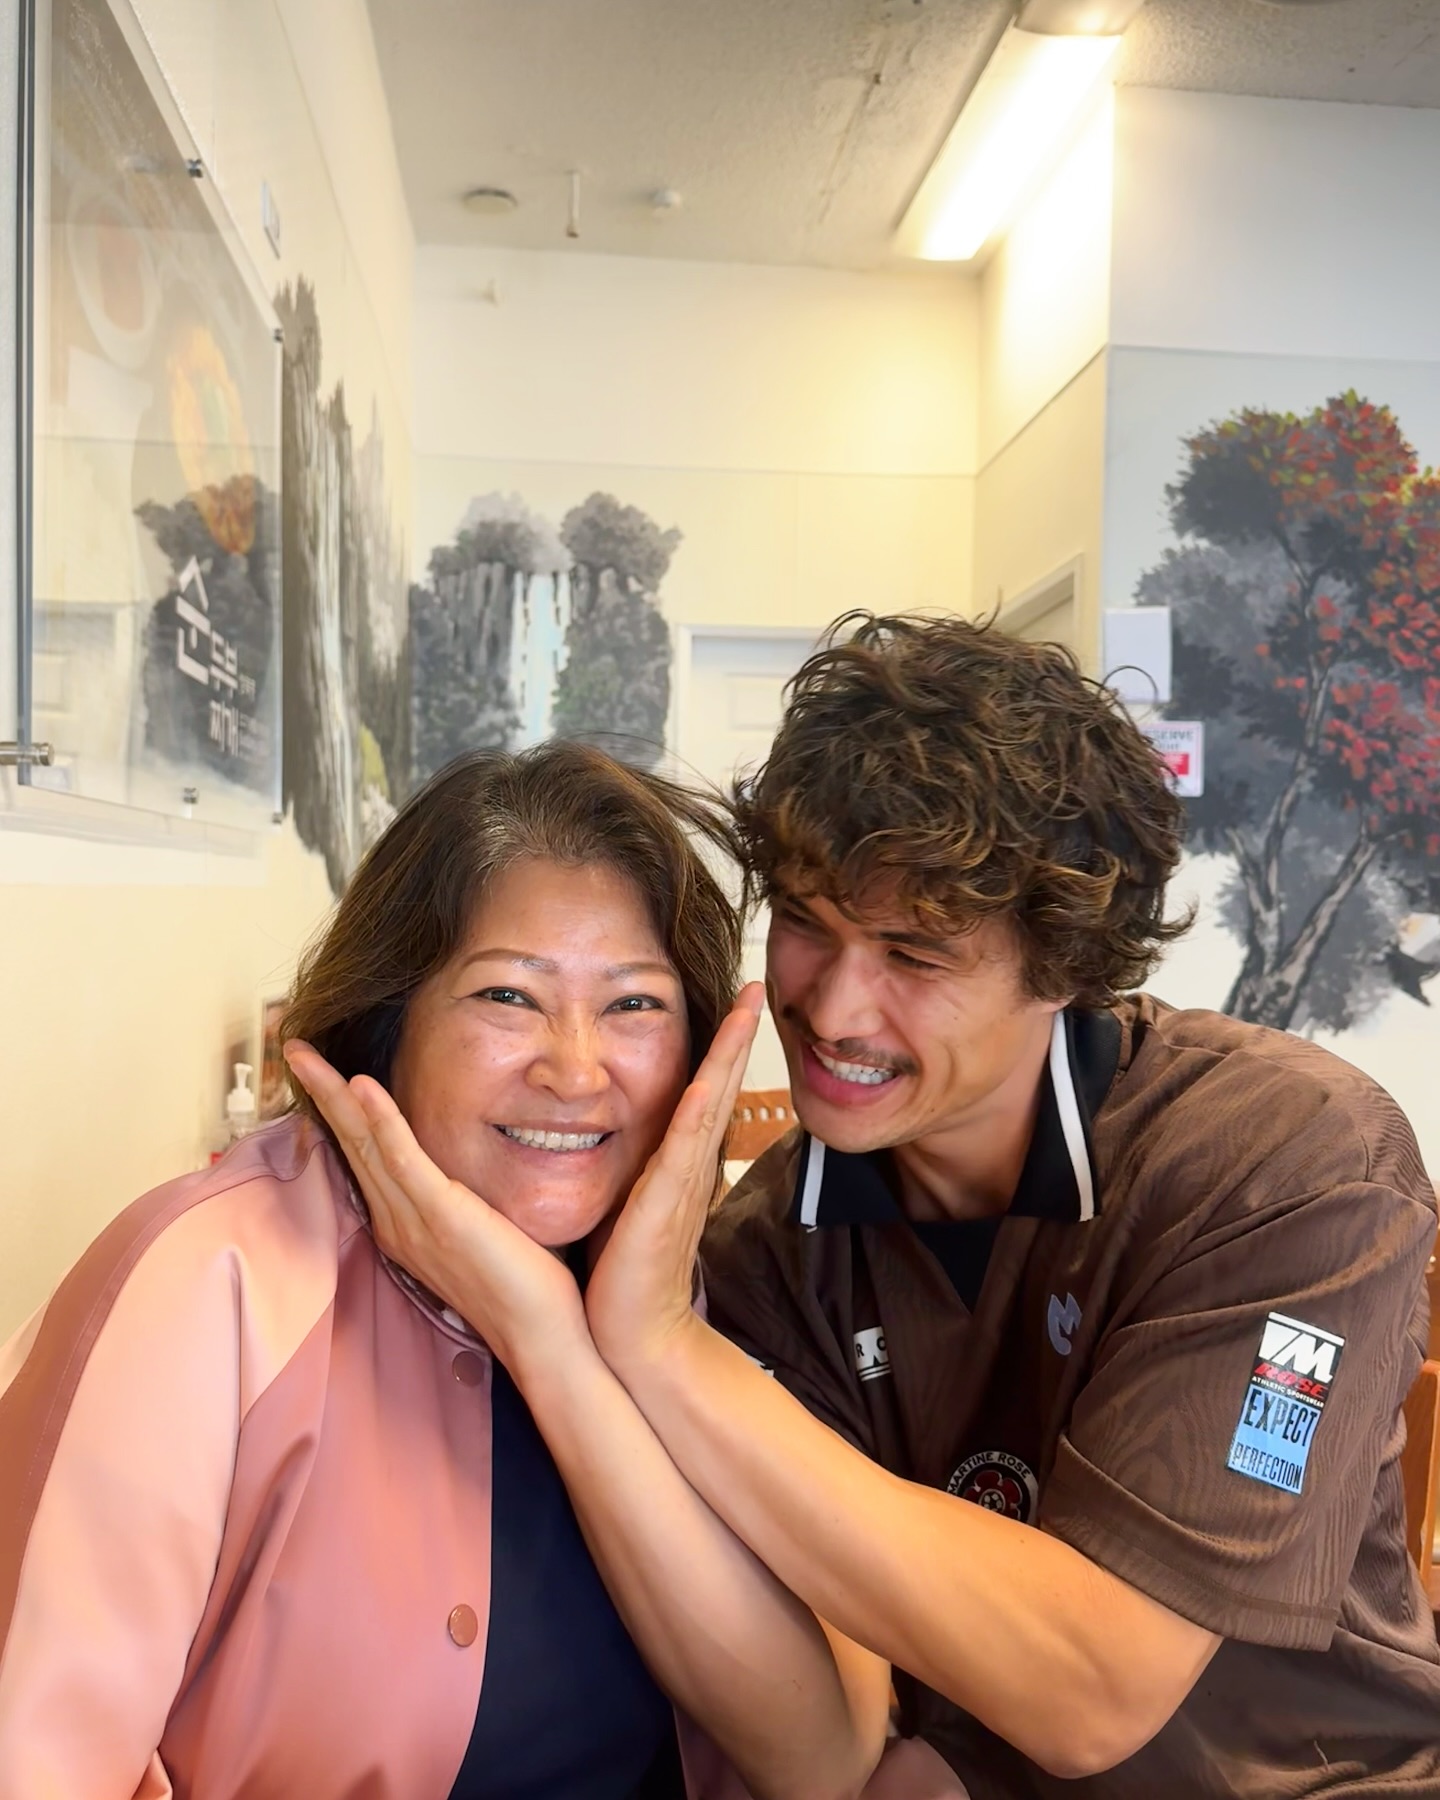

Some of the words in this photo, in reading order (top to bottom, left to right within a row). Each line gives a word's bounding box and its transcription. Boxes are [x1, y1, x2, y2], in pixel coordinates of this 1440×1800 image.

[1252, 1375, 1286, 1393] ATHLETIC
[1286, 1388, 1325, 1408] SPORTSWEAR
[1254, 1362, 1329, 1399] ROSE
[1243, 1387, 1318, 1447] EXPECT
[948, 1452, 994, 1495] MARTINE
[997, 1453, 1031, 1479] ROSE
[1231, 1442, 1303, 1490] PERFECTION
